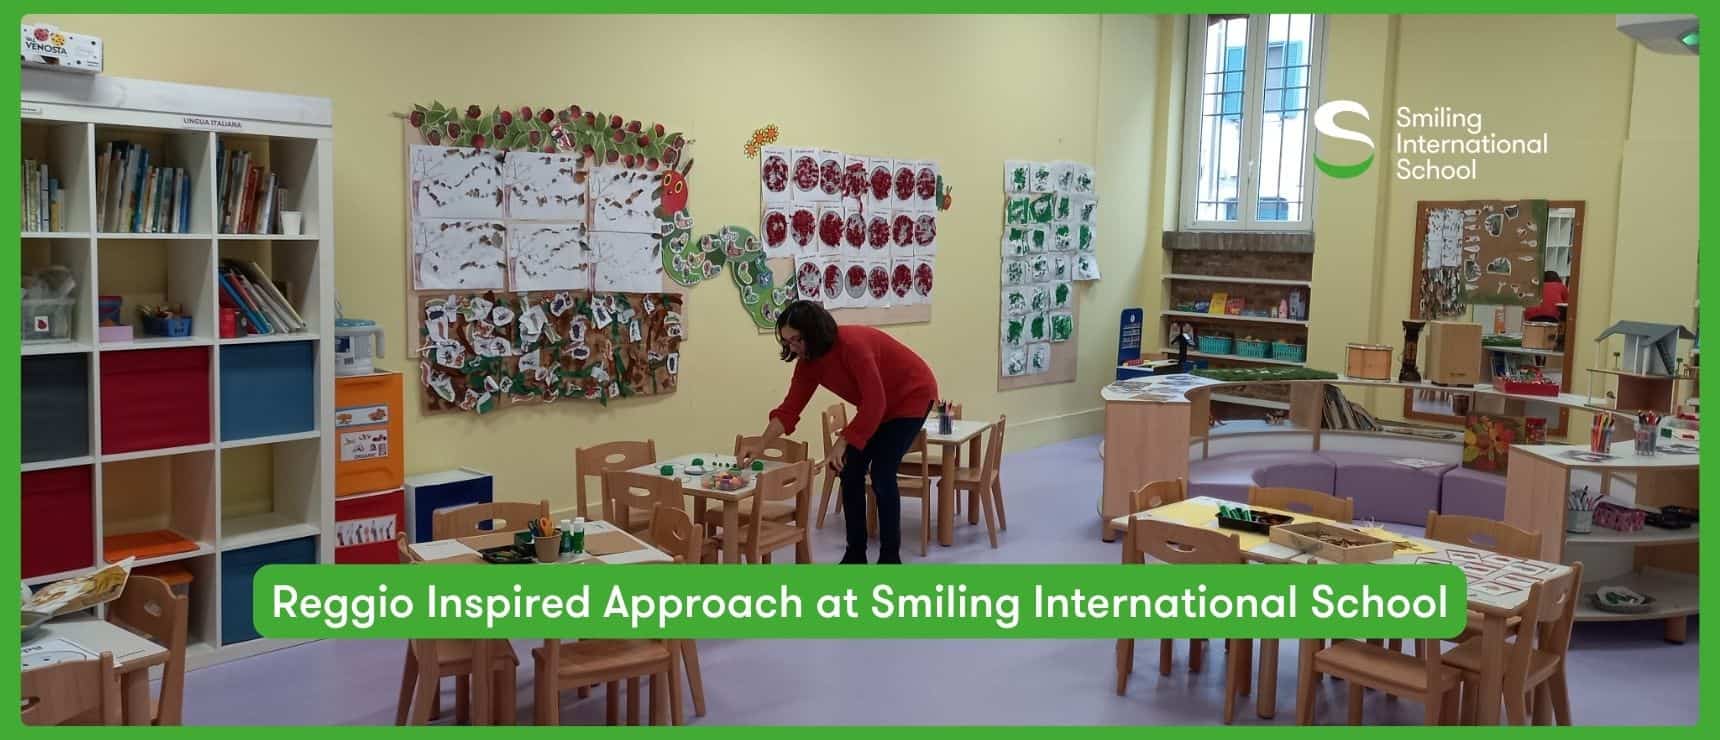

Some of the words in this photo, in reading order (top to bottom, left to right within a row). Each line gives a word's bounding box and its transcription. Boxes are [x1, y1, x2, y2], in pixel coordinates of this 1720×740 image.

[25, 42, 68, 54] VENOSTA
[183, 117, 210, 126] LINGUA
[210, 119, 242, 129] ITALIANA
